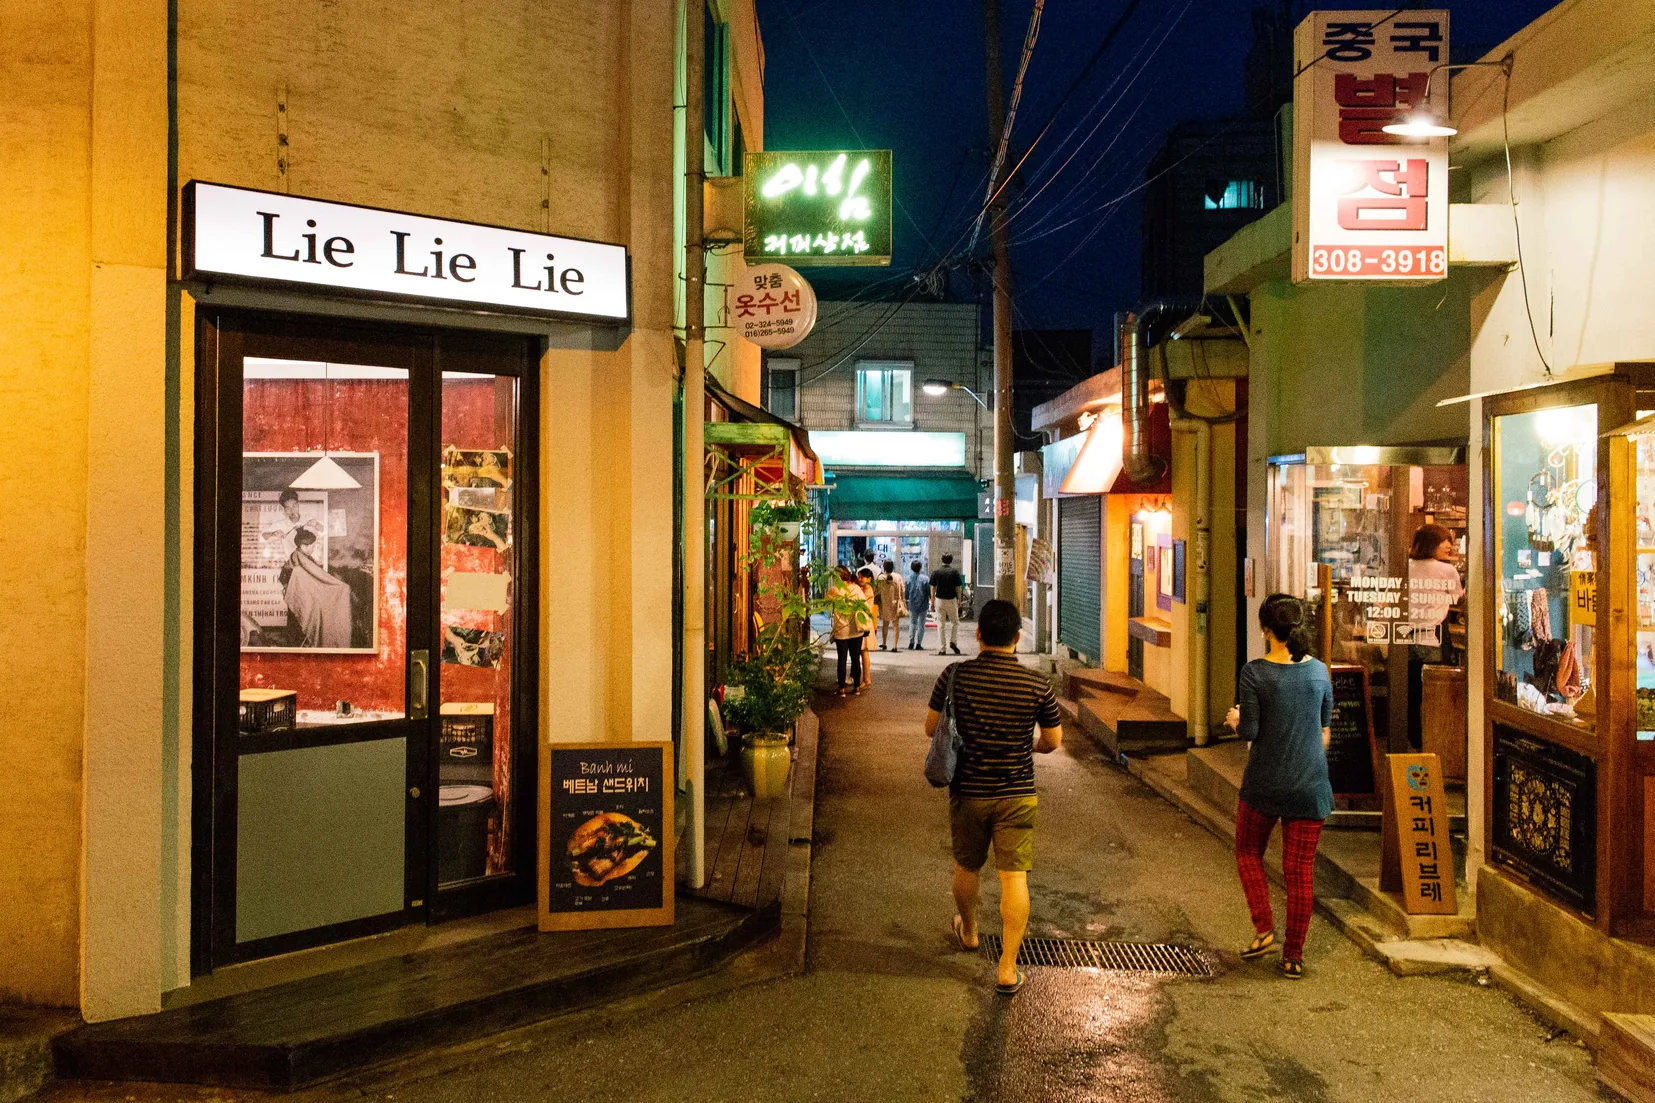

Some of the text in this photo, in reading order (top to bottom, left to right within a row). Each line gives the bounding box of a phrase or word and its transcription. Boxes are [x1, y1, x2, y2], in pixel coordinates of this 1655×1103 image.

[1322, 22, 1443, 62] 중국
[256, 211, 585, 296] Lie Lie Lie
[1313, 249, 1445, 273] 308-3918
[754, 273, 783, 290] 맞춤
[735, 289, 801, 318] 옷수선
[745, 319, 793, 329] 02-324-5949
[1350, 576, 1402, 589] MONDAY
[1409, 578, 1456, 591] CLOSED
[1346, 590, 1401, 603] TUESDAY
[1410, 592, 1459, 605] SUNDAY
[1366, 606, 1400, 618] 12:00
[563, 777, 649, 794] 베트남 샌드위치
[1409, 796, 1442, 902] 커피 리브레
